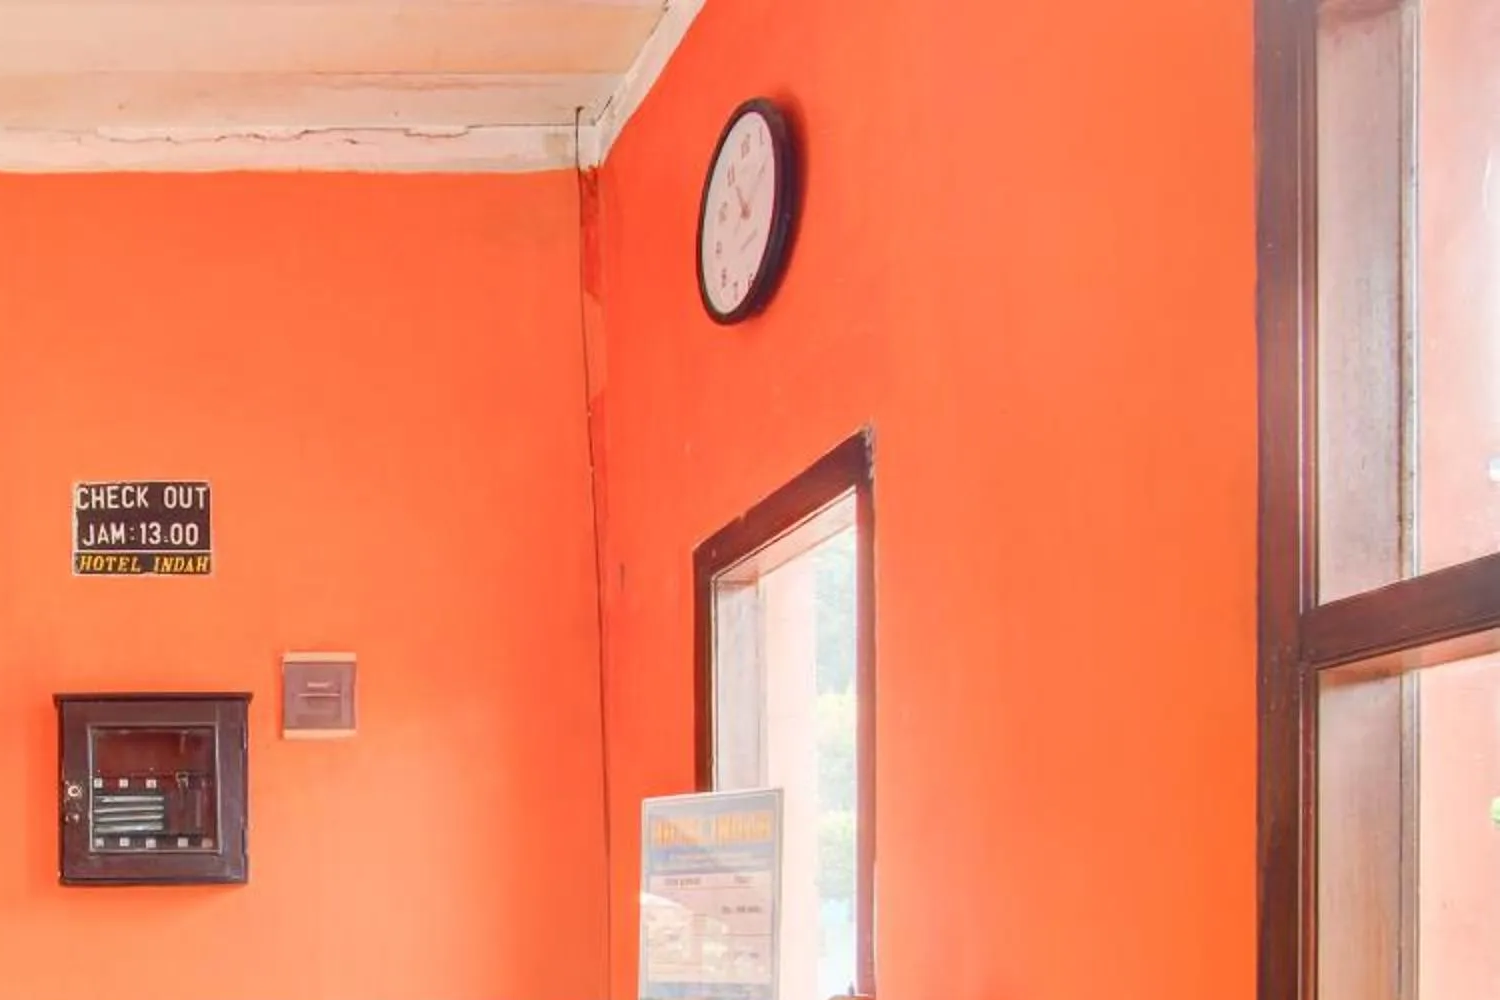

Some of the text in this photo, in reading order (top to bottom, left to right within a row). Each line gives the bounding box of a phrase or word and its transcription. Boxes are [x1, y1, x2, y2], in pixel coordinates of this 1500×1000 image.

[76, 485, 208, 510] CHECK OUT
[79, 555, 210, 573] HOTEL INDAH
